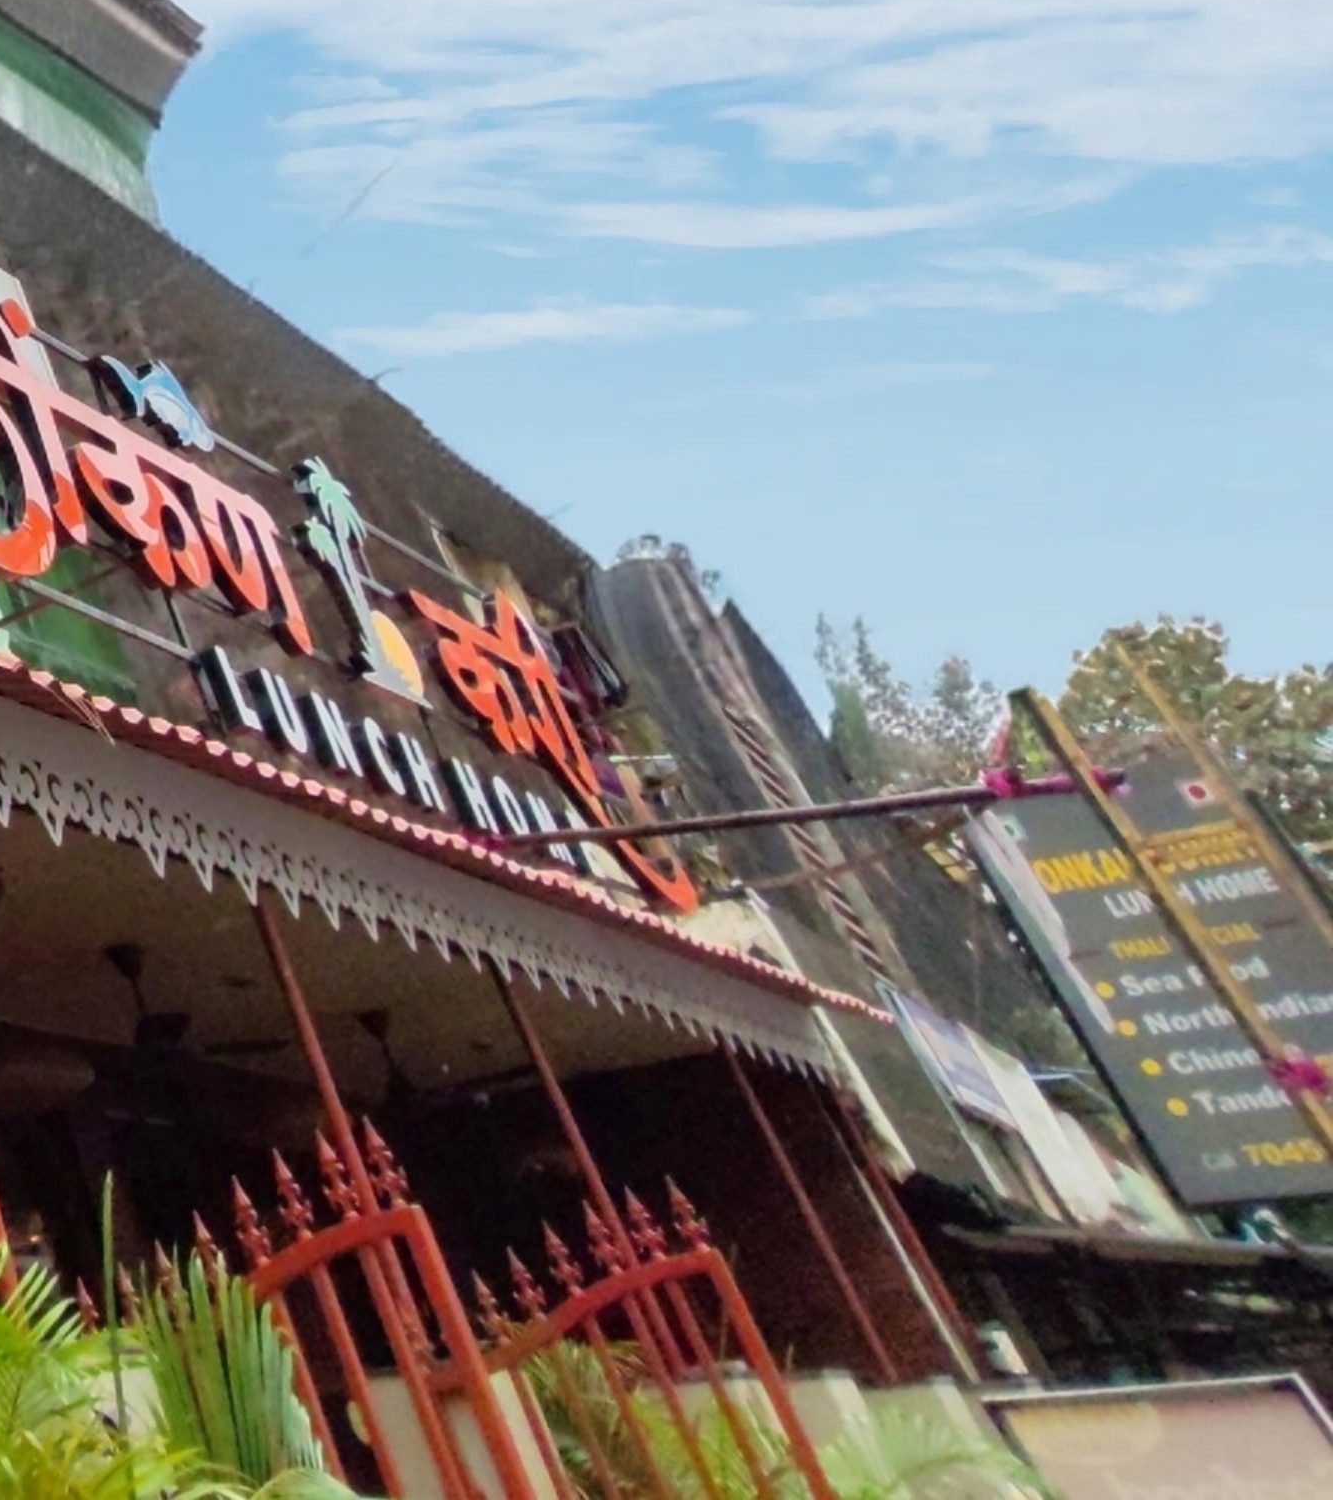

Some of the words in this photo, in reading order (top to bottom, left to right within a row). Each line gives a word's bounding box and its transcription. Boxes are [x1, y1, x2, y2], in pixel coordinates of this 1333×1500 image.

[211, 644, 446, 814] LUNCH
[1102, 882, 1198, 919] LUNH
[1195, 866, 1281, 903] HOME
[1119, 973, 1185, 997] Sea
[1141, 1002, 1237, 1036] North
